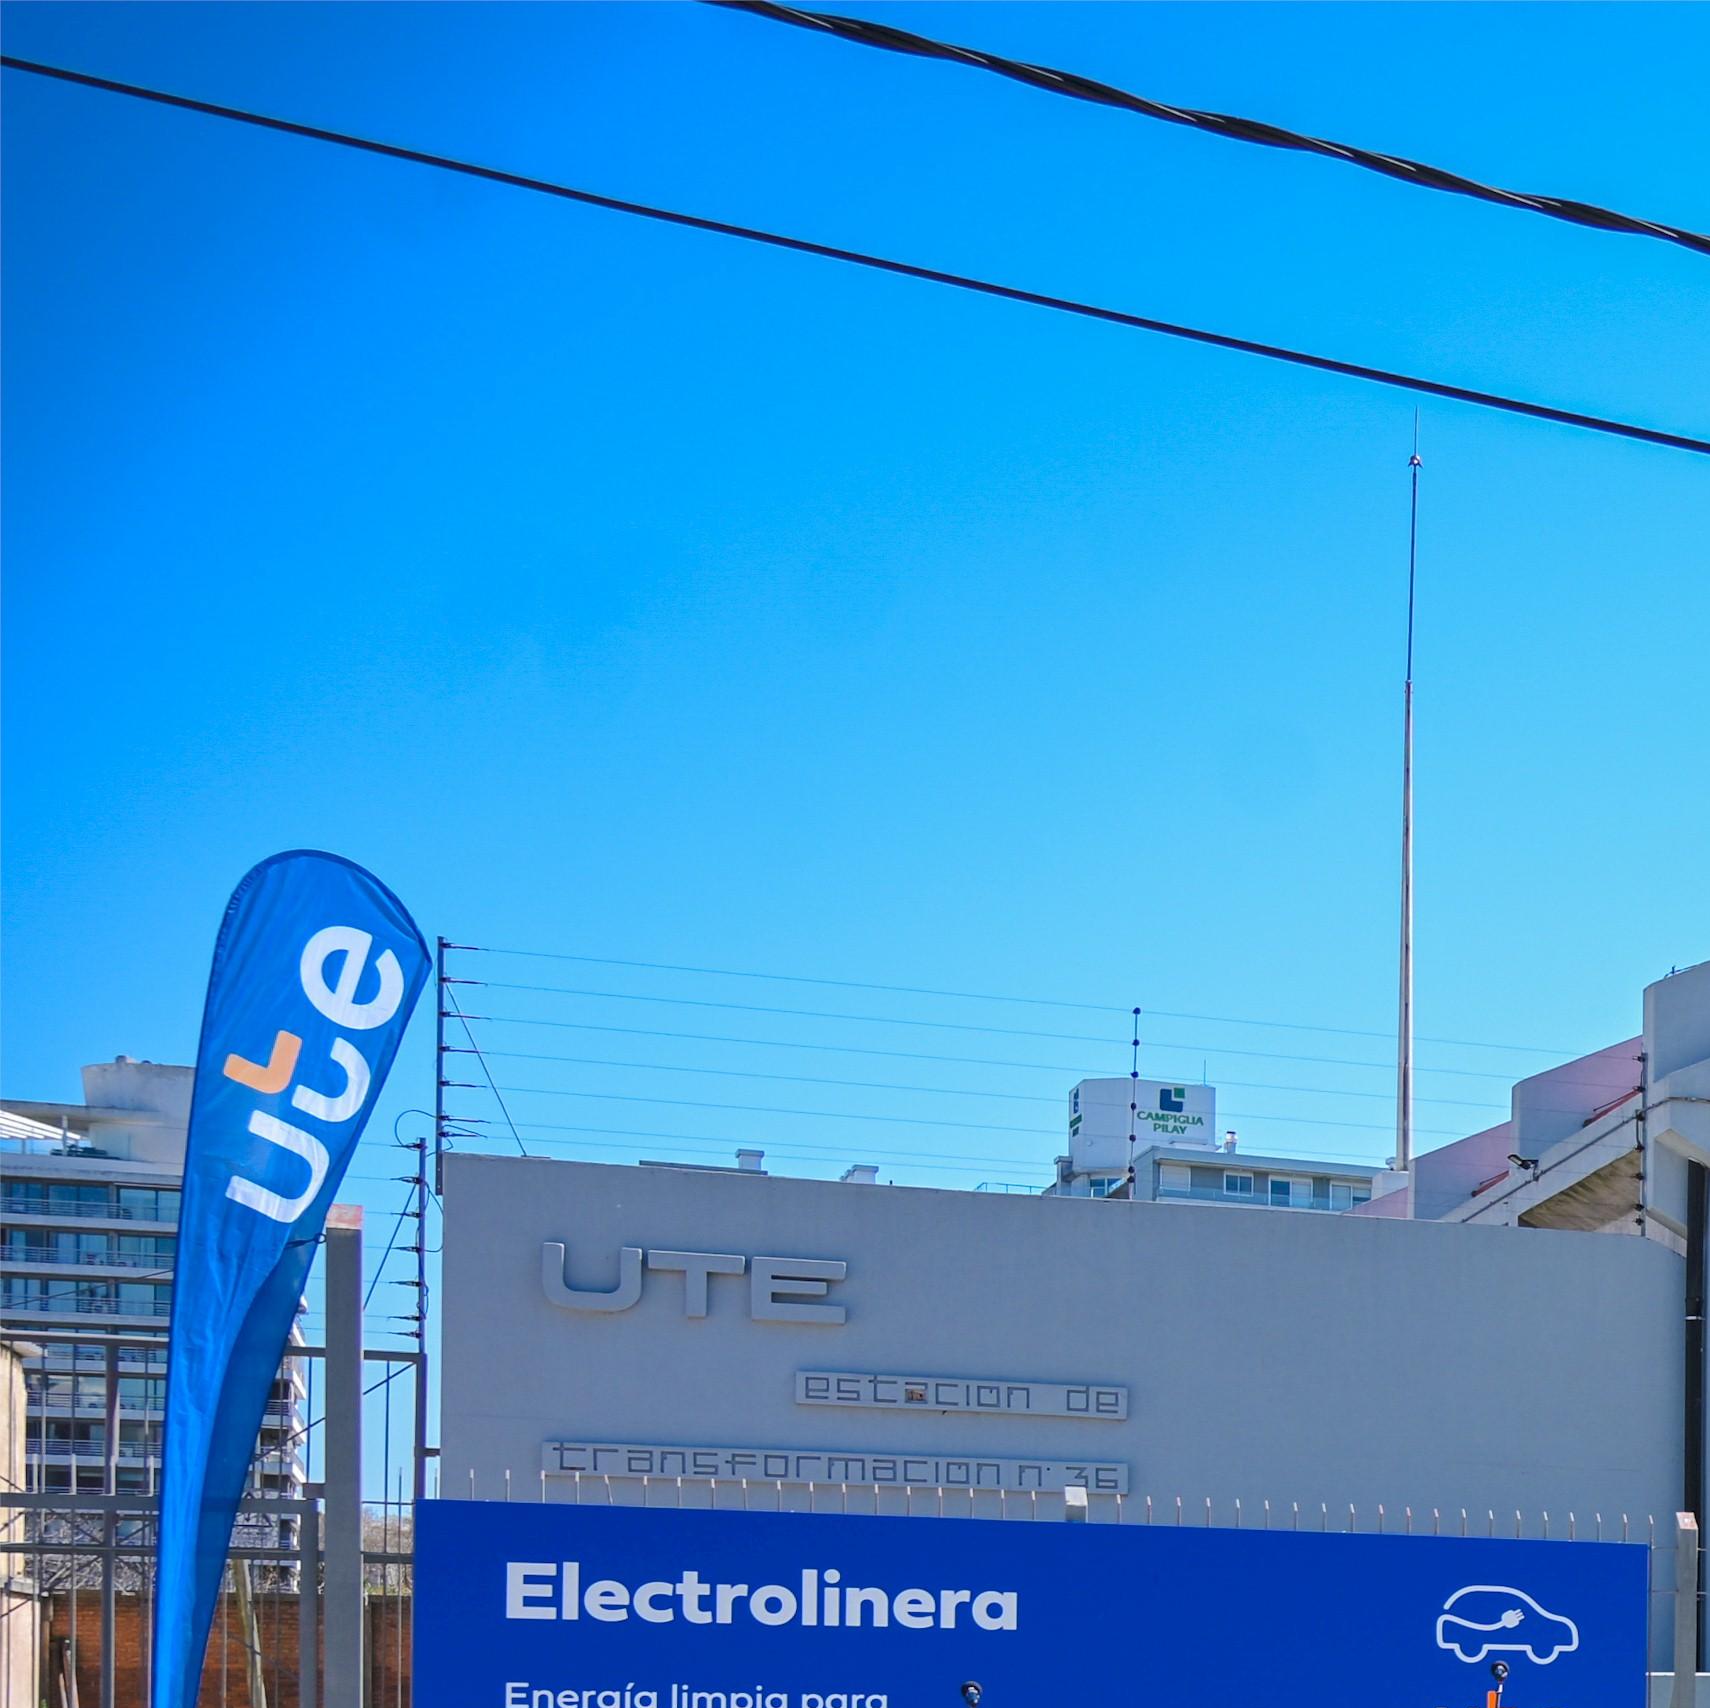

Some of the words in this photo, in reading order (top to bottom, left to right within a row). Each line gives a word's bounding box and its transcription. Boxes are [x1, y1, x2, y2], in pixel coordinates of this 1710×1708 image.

[224, 926, 404, 1223] ute
[1137, 1111, 1204, 1126] CAMPIGLIA
[1153, 1123, 1187, 1135] PILAY
[543, 1242, 847, 1325] UTE
[804, 1374, 1030, 1410] estacion
[1067, 1386, 1119, 1413] de
[553, 1443, 1000, 1486] transformacion
[505, 1561, 1018, 1631] Electrolinera
